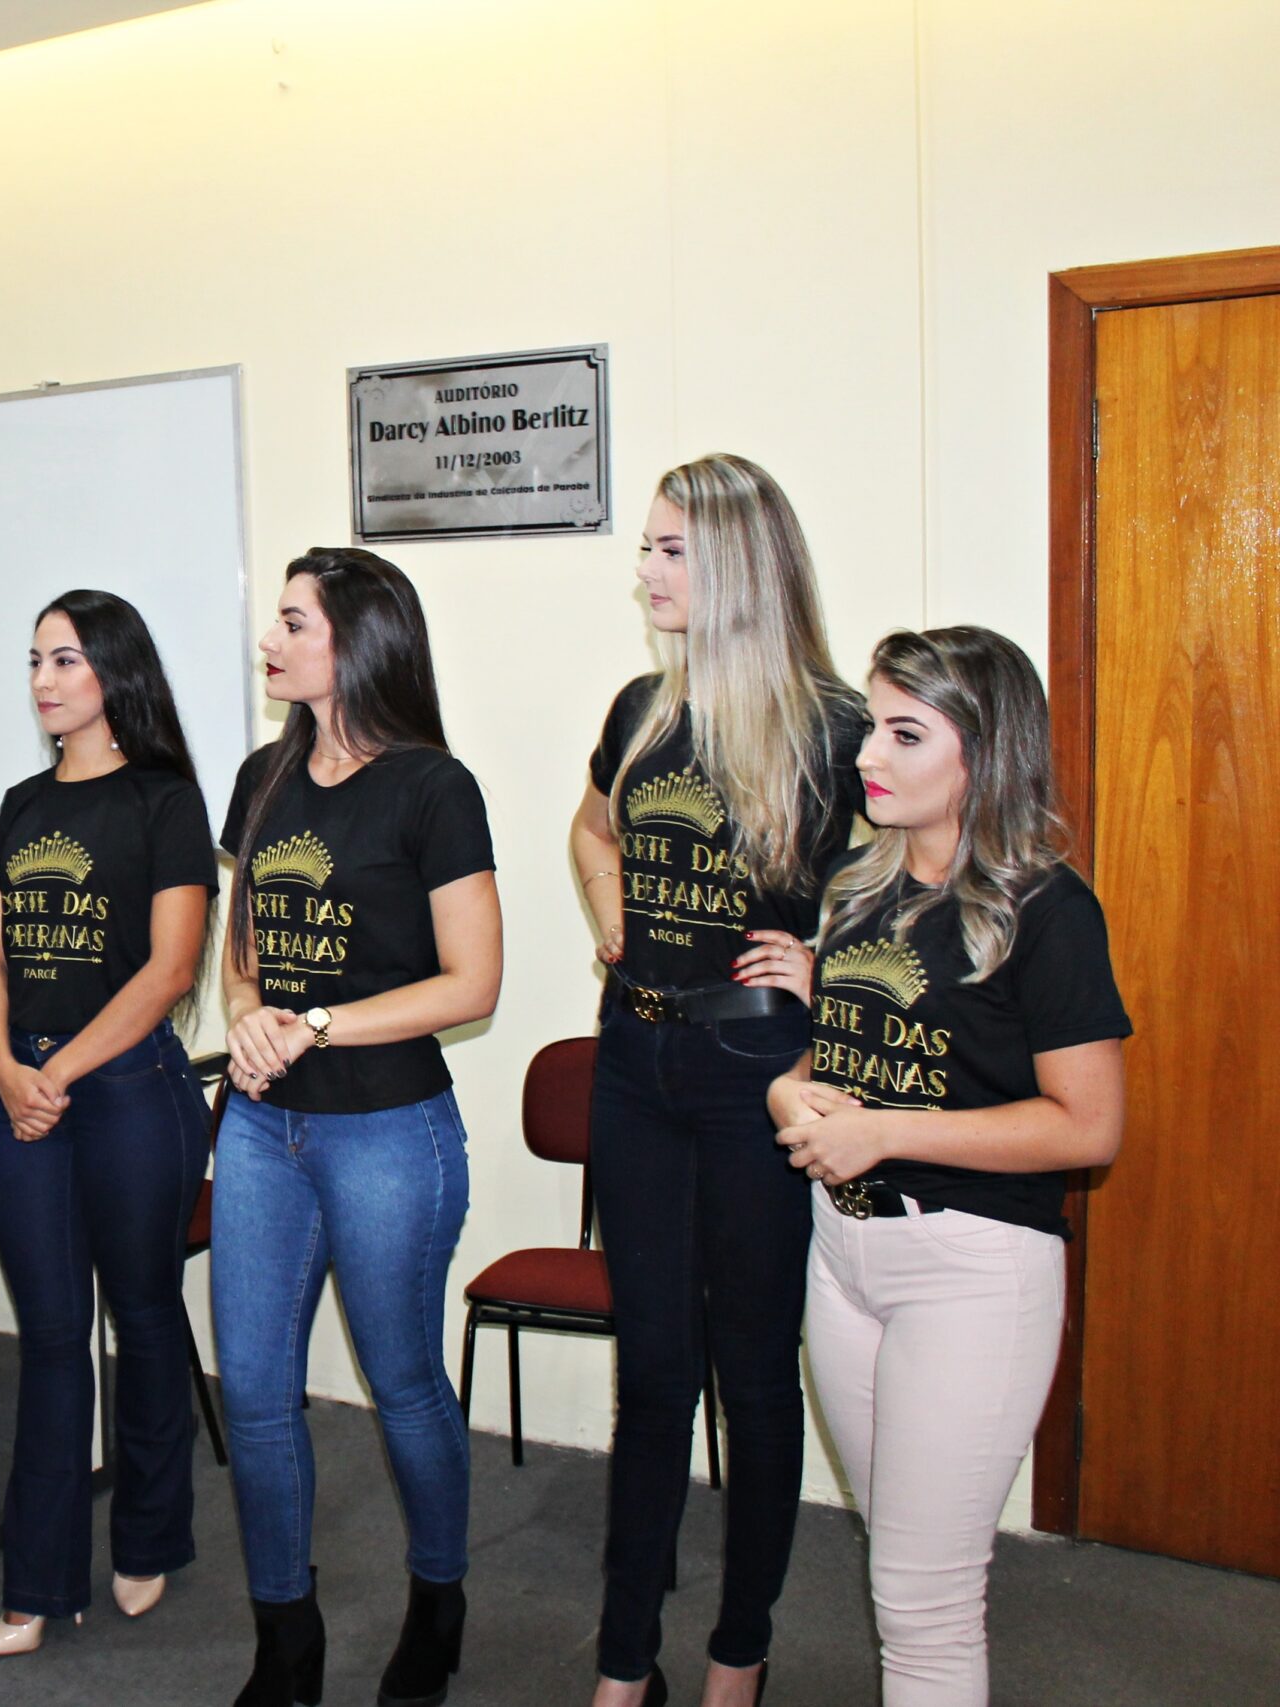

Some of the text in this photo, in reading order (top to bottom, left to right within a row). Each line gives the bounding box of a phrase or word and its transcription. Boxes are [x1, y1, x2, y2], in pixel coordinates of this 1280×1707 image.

[434, 382, 519, 404] AUDITÓRIO
[369, 404, 589, 443] Darcy Albino Berlitz
[435, 450, 522, 470] 11/12/2003
[475, 487, 488, 496] de
[537, 484, 550, 492] de
[622, 832, 750, 879] ORTE DAS
[1, 890, 109, 920] ORTE DAS
[251, 893, 355, 927] RTE DAS
[622, 871, 748, 917] OBERANAS
[254, 929, 348, 963] BERANAS
[648, 928, 693, 946] AROBÉ
[811, 994, 952, 1057] RTE DAS
[812, 1037, 949, 1098] BERANAS
